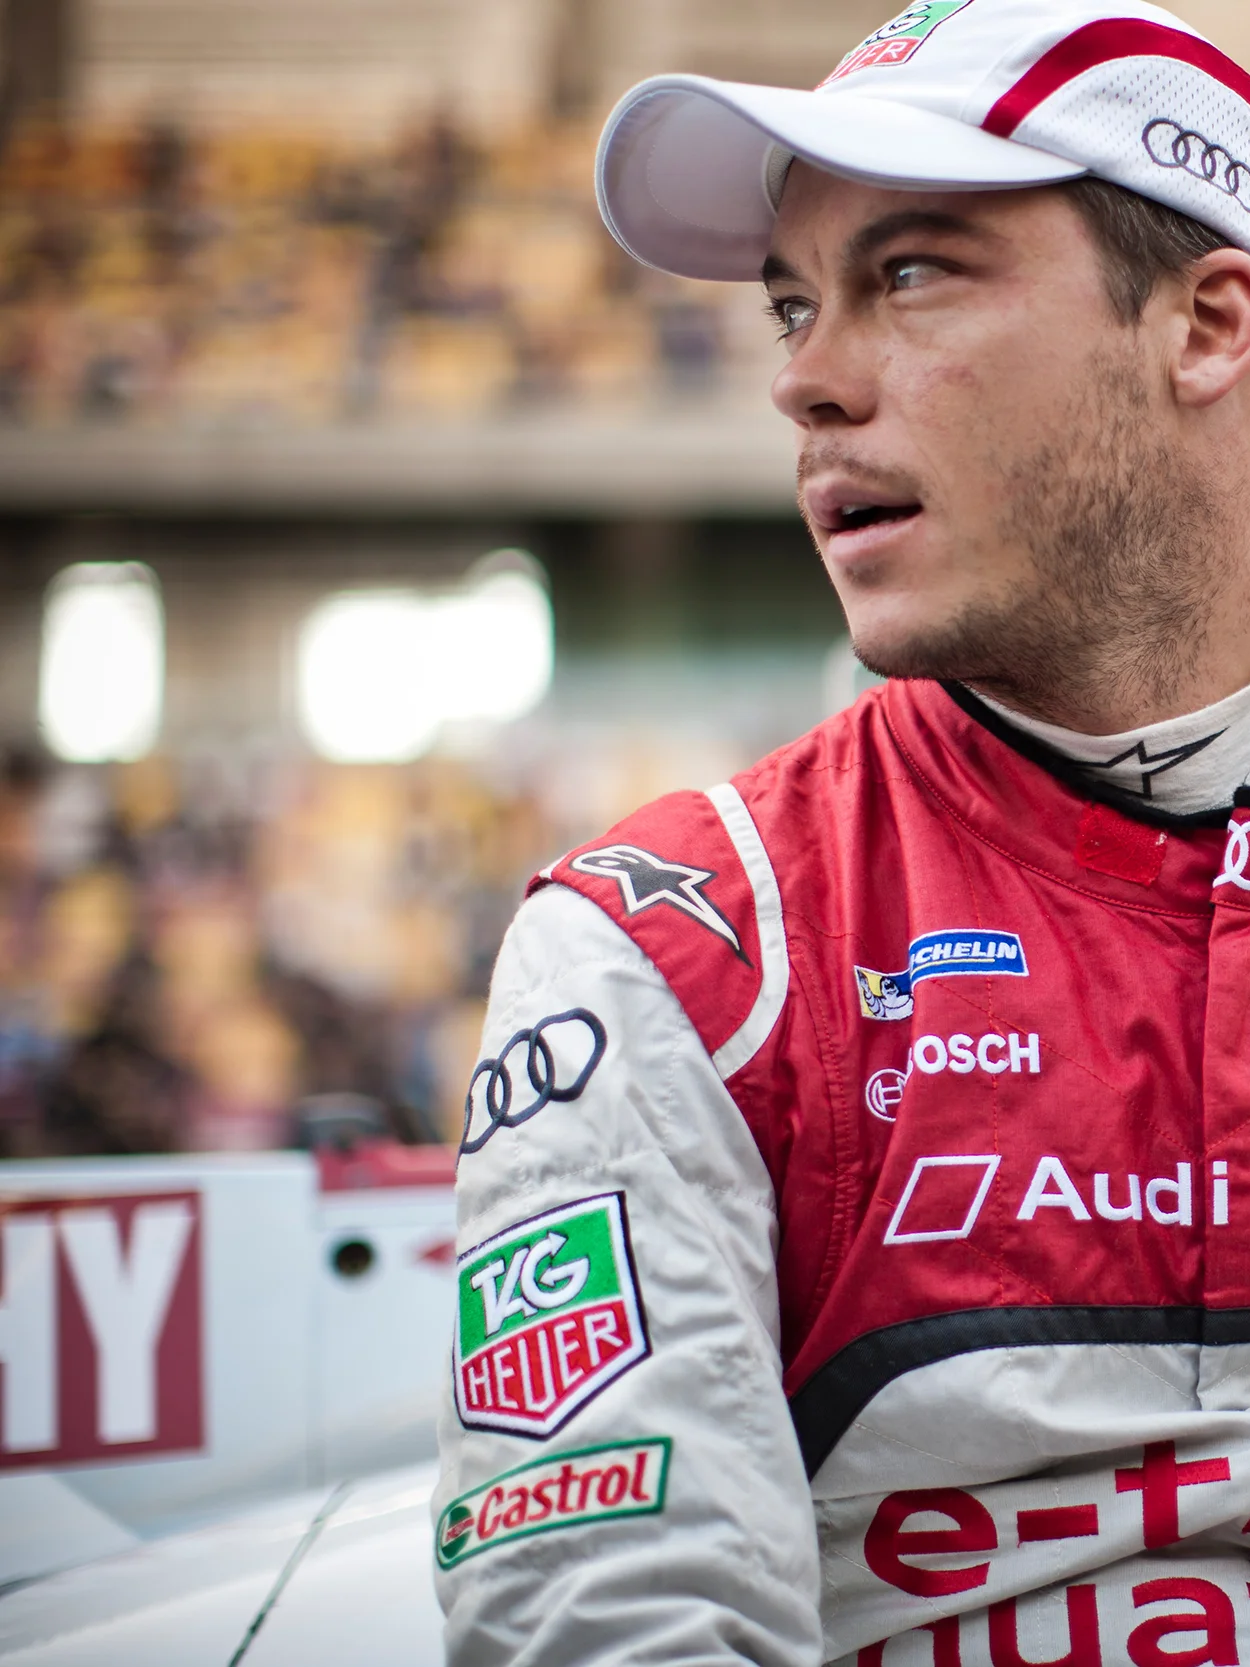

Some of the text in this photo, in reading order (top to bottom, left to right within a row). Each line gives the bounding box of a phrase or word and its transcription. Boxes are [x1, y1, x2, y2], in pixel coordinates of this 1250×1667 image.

[910, 942, 1018, 966] CHELIN
[906, 1033, 1041, 1078] OSCH
[1016, 1155, 1229, 1226] Audi
[471, 1231, 591, 1337] TAG
[468, 1308, 624, 1412] HEUER
[476, 1452, 650, 1541] Castrol
